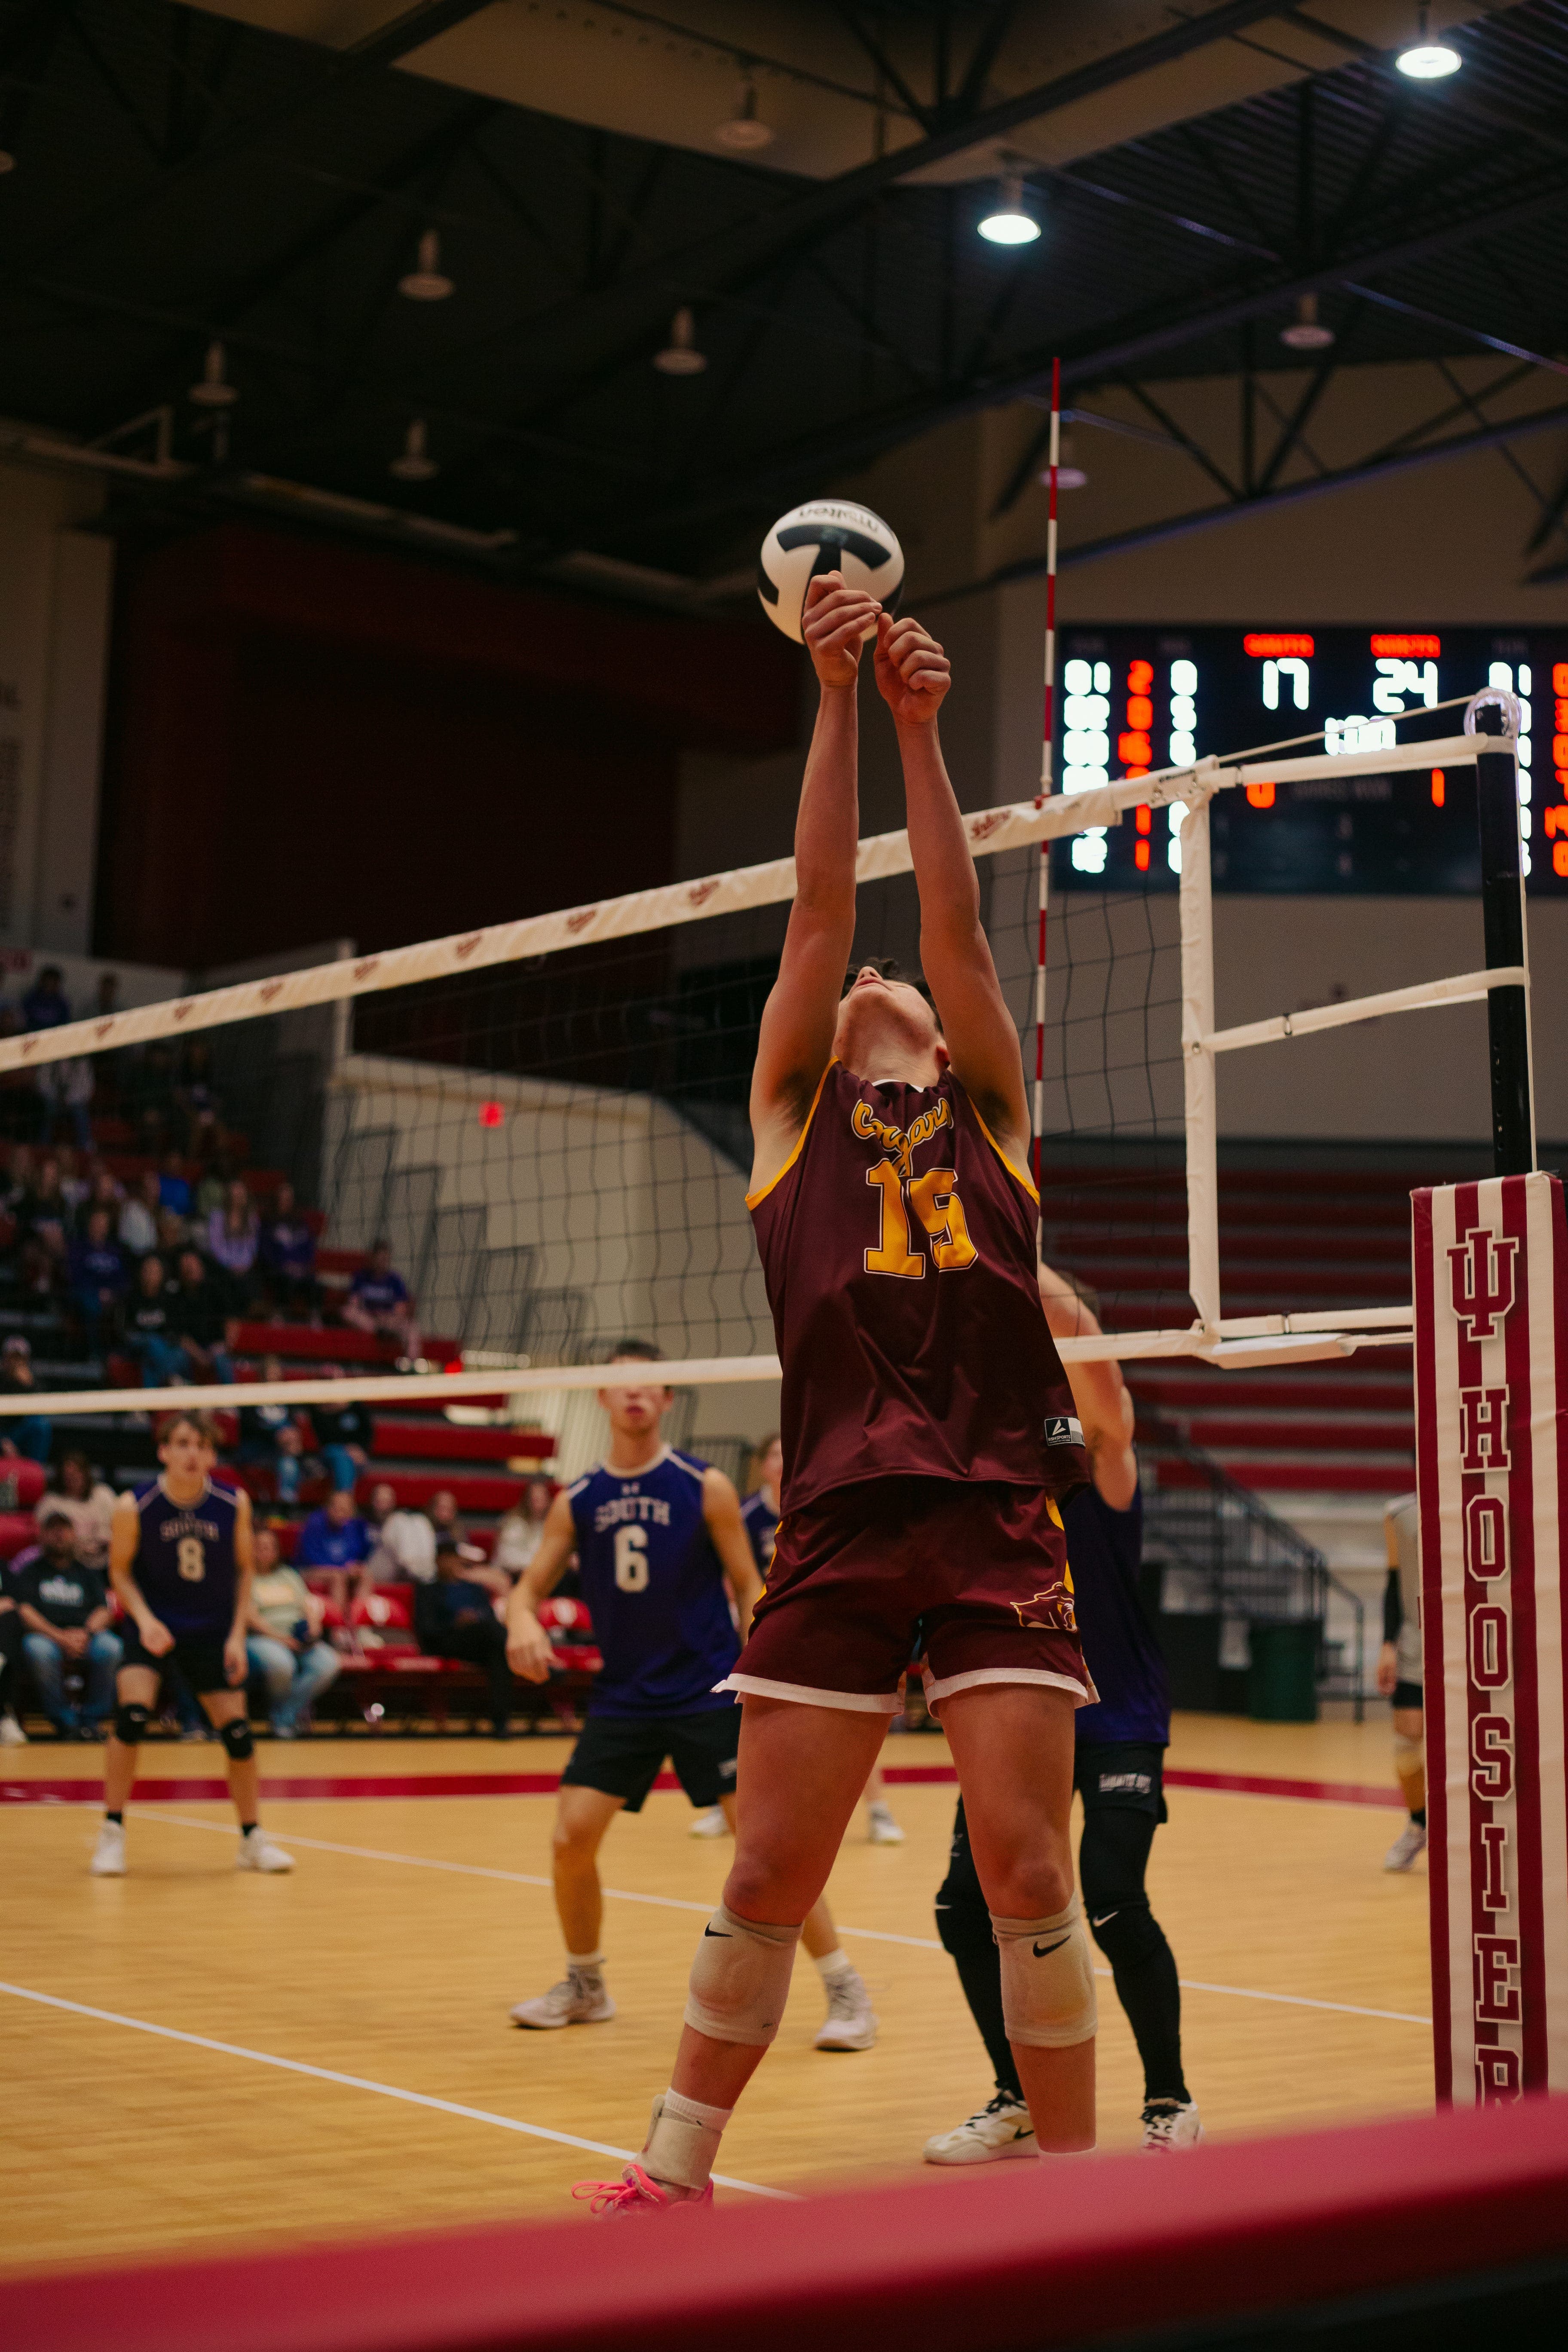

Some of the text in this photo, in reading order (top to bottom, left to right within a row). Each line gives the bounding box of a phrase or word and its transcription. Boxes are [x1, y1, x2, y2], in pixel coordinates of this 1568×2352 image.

[1263, 658, 1309, 710] 17
[1374, 658, 1438, 712] 24
[176, 1536, 206, 1583] 8
[614, 1525, 649, 1592] 6
